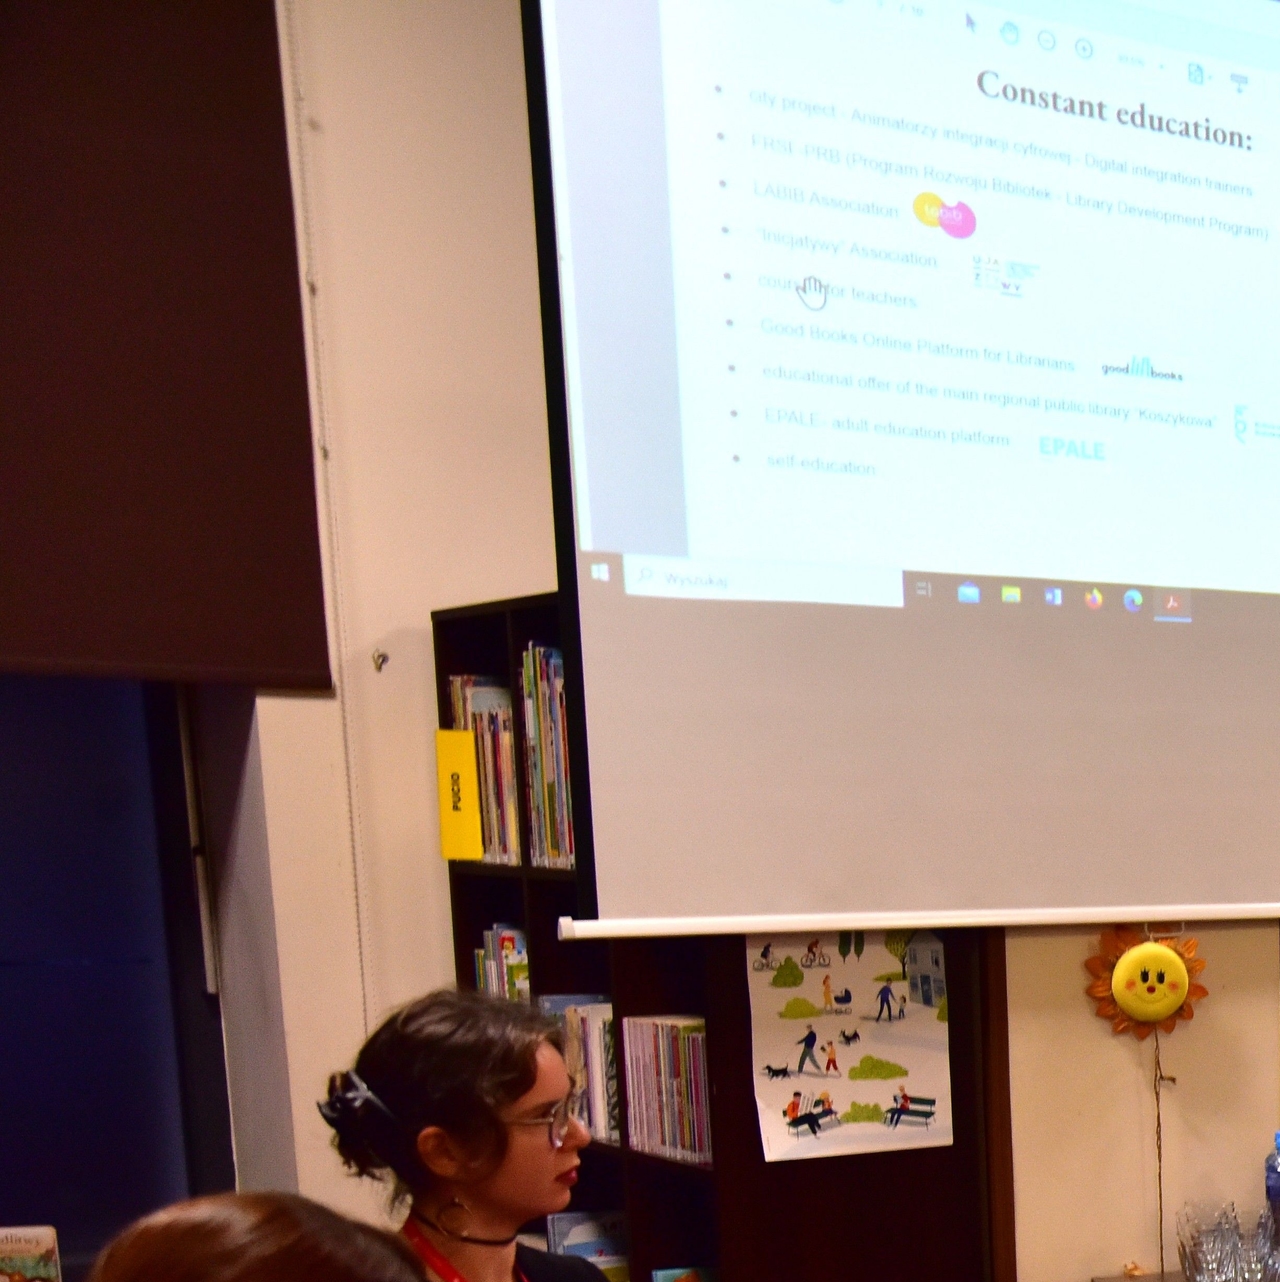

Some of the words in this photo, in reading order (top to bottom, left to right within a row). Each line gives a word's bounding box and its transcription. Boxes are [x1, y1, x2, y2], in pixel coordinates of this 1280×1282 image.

[976, 69, 1108, 122] Constant
[1116, 102, 1254, 152] education:
[781, 97, 837, 120] project
[851, 108, 938, 140] Animatorzy
[1013, 140, 1072, 166] cyfrowej
[1084, 152, 1128, 176] Digital
[1131, 163, 1201, 189] integration
[1204, 174, 1256, 198] trainers
[753, 180, 805, 204] LABIB
[809, 191, 900, 220] Association
[845, 151, 920, 179] (Program
[923, 165, 988, 192] Rozwoju
[991, 176, 1051, 202] Bibliotek
[1065, 190, 1114, 217] Library
[1117, 201, 1205, 229] Development
[1208, 215, 1270, 243] Program)
[850, 242, 939, 269] Association
[851, 286, 919, 310] teachers
[760, 317, 805, 339] Good
[809, 324, 858, 345] Books
[862, 331, 912, 352] Online
[916, 338, 980, 362] Platform
[983, 347, 1002, 363] for
[1005, 350, 1076, 374] Librarians
[1102, 363, 1130, 376] good
[1150, 366, 1184, 382] books
[762, 365, 853, 388] educational
[857, 375, 892, 394] offer
[896, 379, 912, 394] of
[915, 382, 940, 398] the
[943, 387, 980, 403] main
[983, 391, 1041, 414] regional
[1044, 397, 1085, 418] public
[1087, 401, 1131, 424] library
[831, 417, 869, 434] adult
[873, 423, 947, 443] education
[950, 429, 1012, 449] platform
[1038, 436, 1107, 462] EPALE
